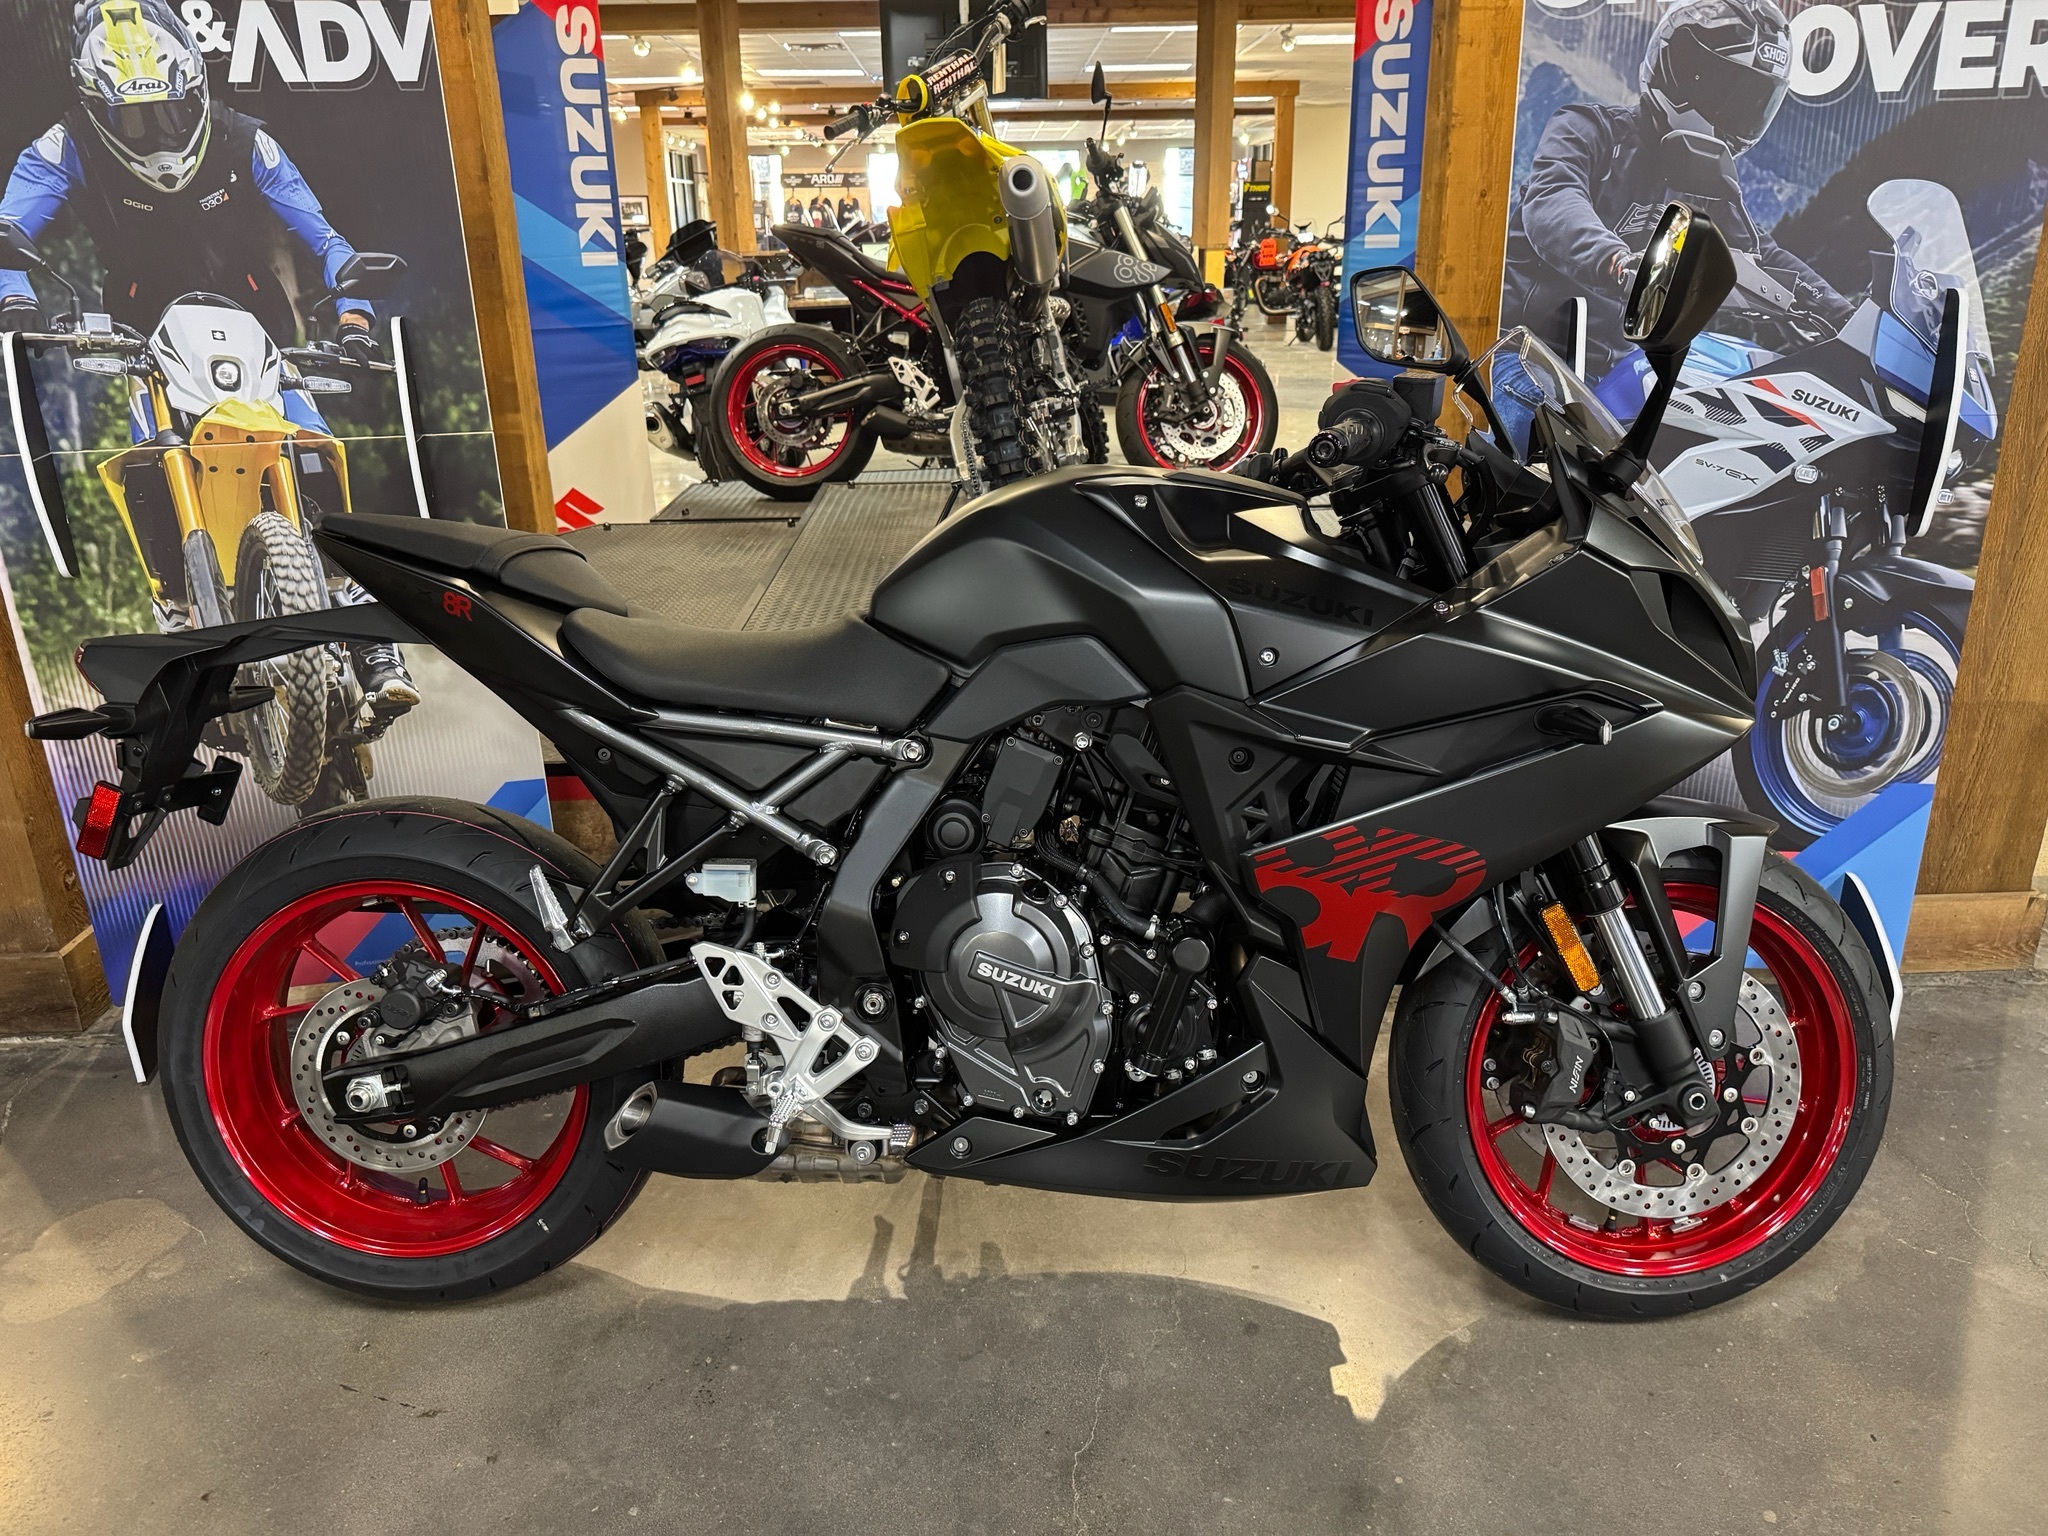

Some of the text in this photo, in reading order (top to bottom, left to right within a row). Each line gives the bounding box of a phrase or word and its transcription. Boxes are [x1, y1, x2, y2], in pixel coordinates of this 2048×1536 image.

[121, 80, 163, 94] Arai
[926, 53, 974, 86] RENTHAL
[933, 60, 978, 95] RENTHAL
[555, 4, 619, 267] SUZUKI
[1364, 0, 1415, 249] SUZUKI
[123, 198, 154, 211] OGIO
[1113, 254, 1158, 285] 8S
[1791, 388, 1861, 423] SUZUKI
[443, 591, 473, 622] 8R
[1226, 576, 1375, 627] SUZUKI
[976, 961, 1057, 999] SUZUKI
[1569, 1054, 1584, 1094] NISSIN
[1143, 1150, 1353, 1187] SUZUKI
